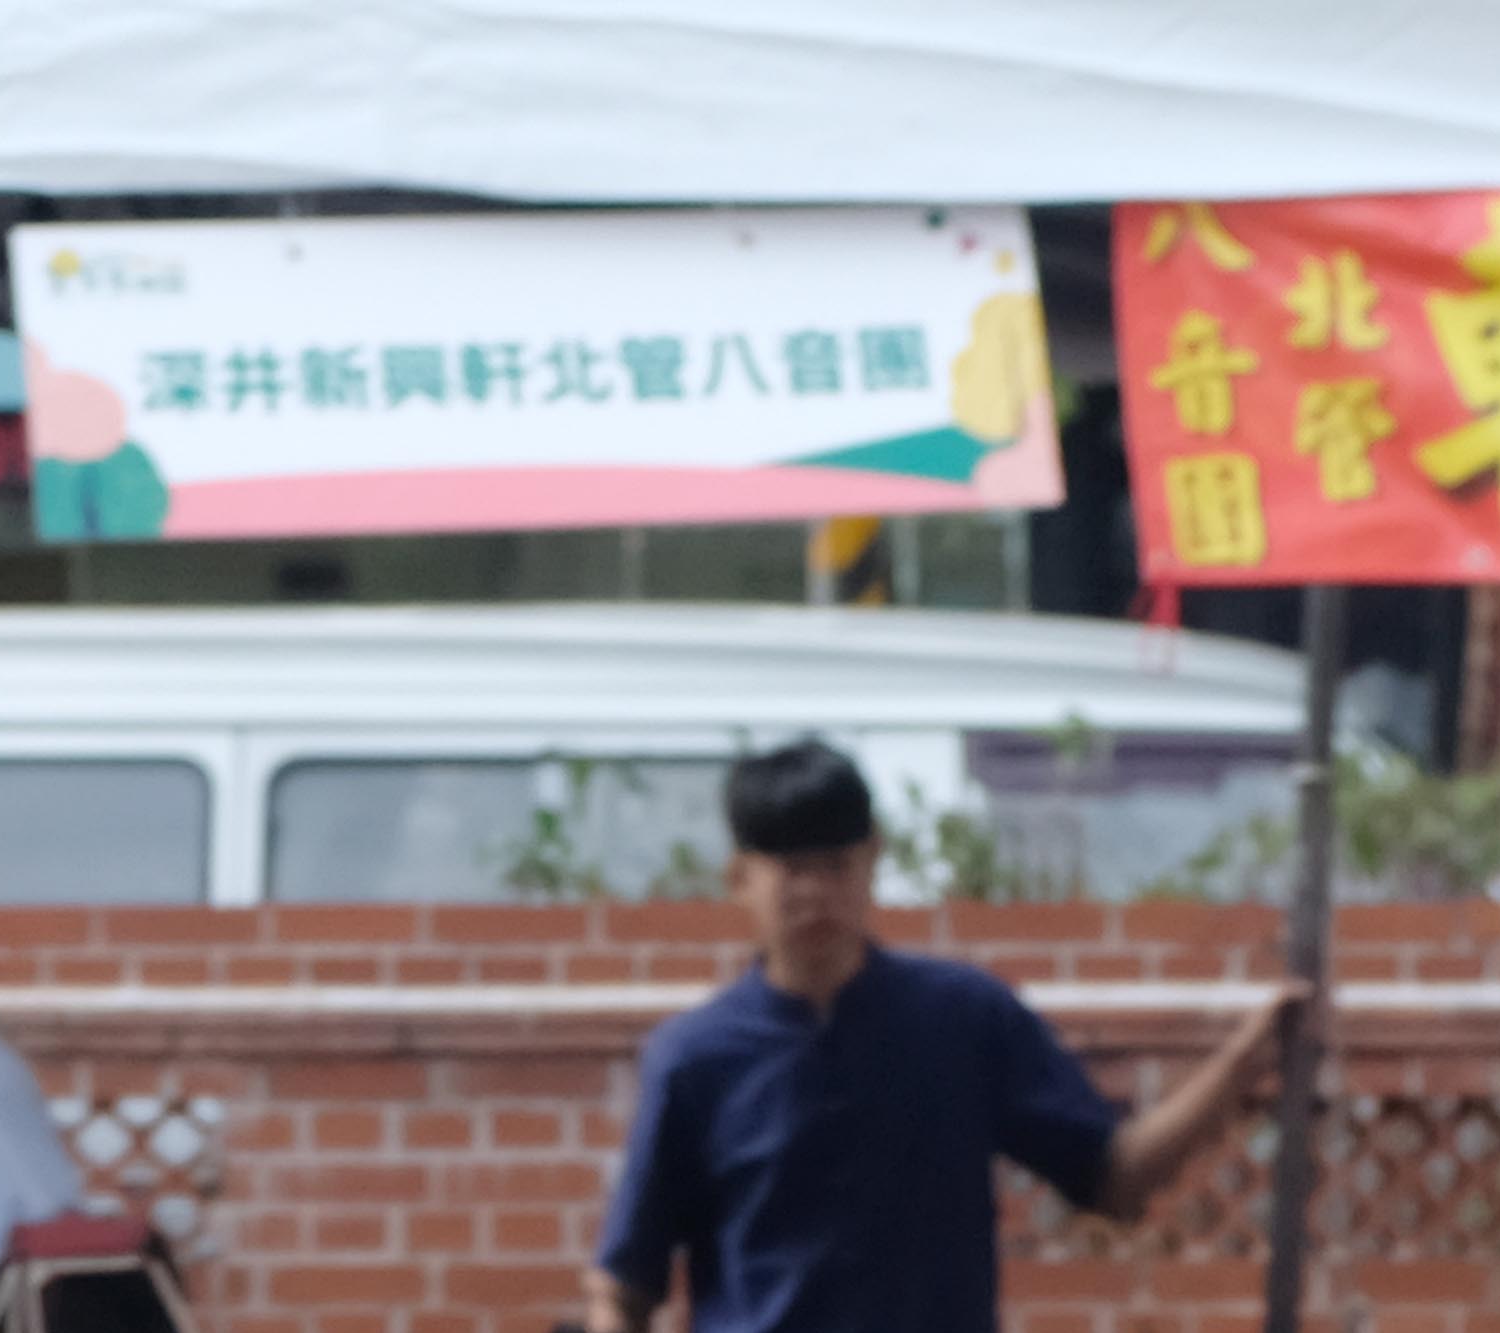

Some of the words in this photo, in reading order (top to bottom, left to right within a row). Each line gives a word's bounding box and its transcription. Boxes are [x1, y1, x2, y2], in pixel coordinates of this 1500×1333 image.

[141, 324, 932, 415] 深井新興軒北管八音團
